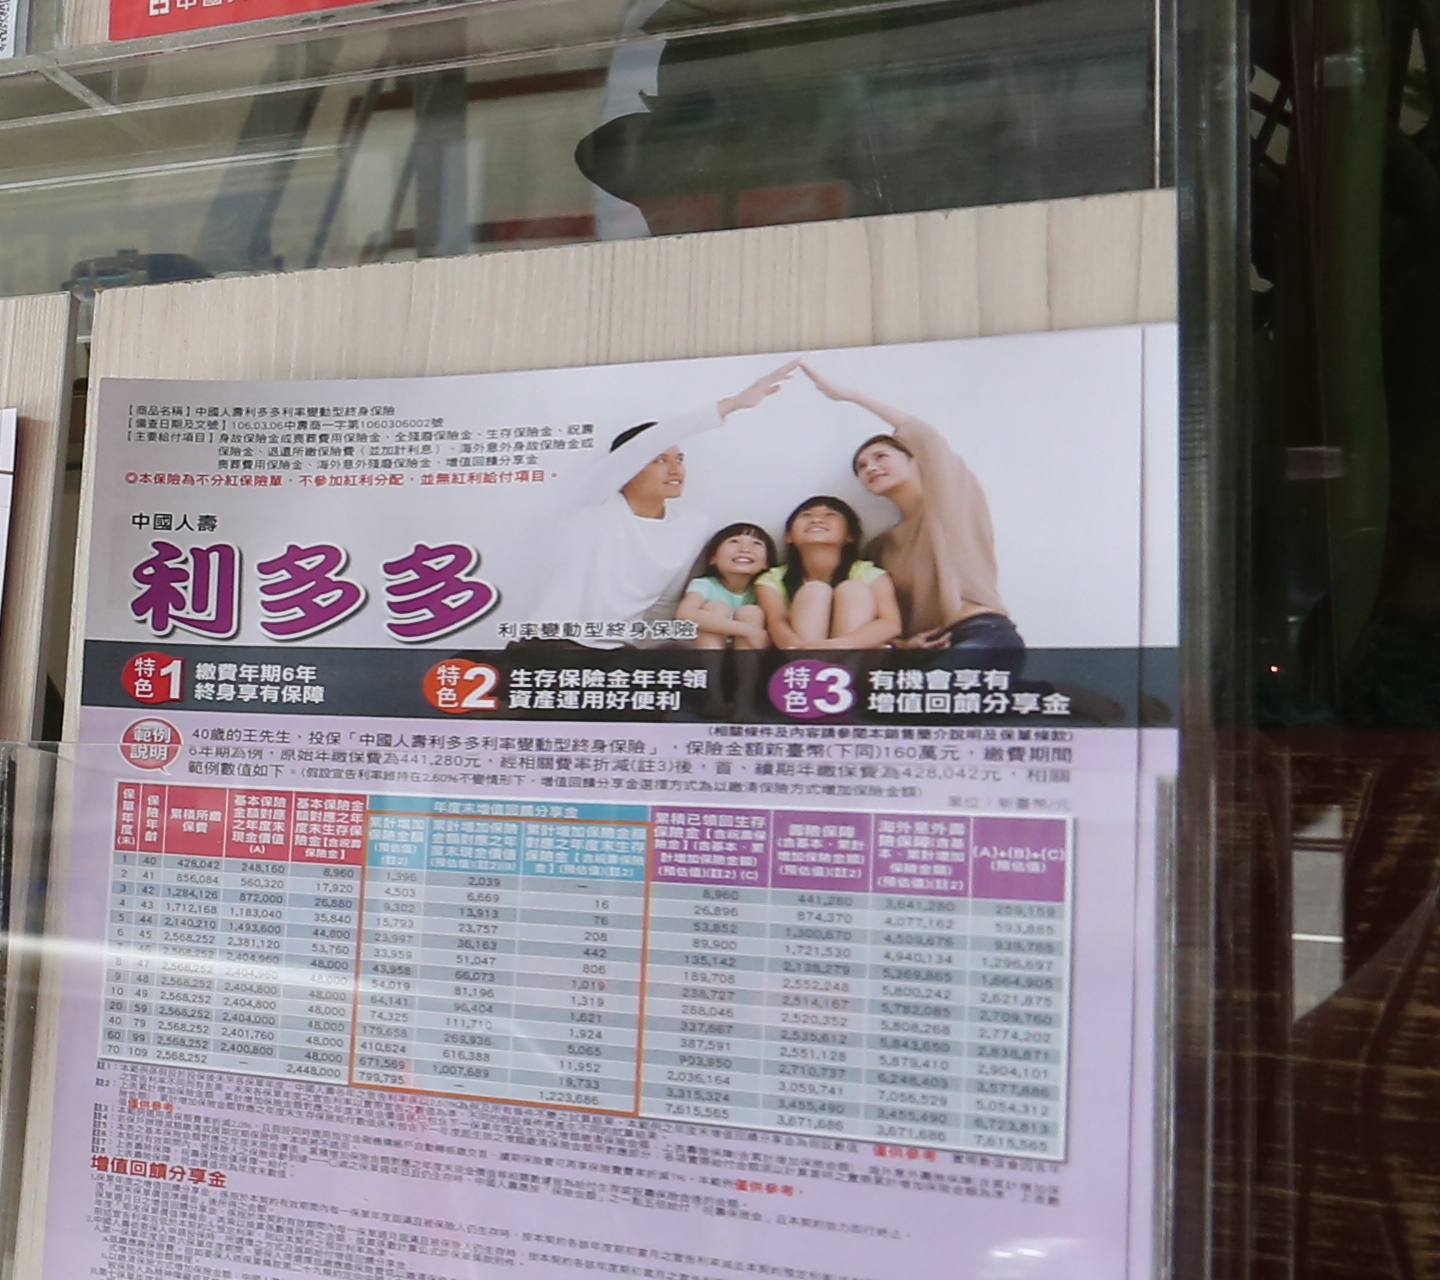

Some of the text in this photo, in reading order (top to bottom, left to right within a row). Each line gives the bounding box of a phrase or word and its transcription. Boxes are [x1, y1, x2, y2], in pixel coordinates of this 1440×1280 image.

[131, 513, 218, 532] 中國人壽
[129, 540, 698, 643] 利多多 利率變動型終身保險
[133, 658, 183, 701] 特色 1
[195, 662, 317, 682] 繳費年期6年
[509, 667, 708, 689] 生存保險金年年領
[870, 668, 1010, 692] 有機會享有
[194, 683, 325, 704] 終身享有保障
[436, 665, 498, 709] 特色 2
[782, 663, 854, 713] 特色 3
[508, 689, 680, 711] 資產運用好便利
[866, 691, 1071, 717] 增值回饋分享金
[131, 725, 173, 745] 範例
[131, 742, 172, 763] 說明
